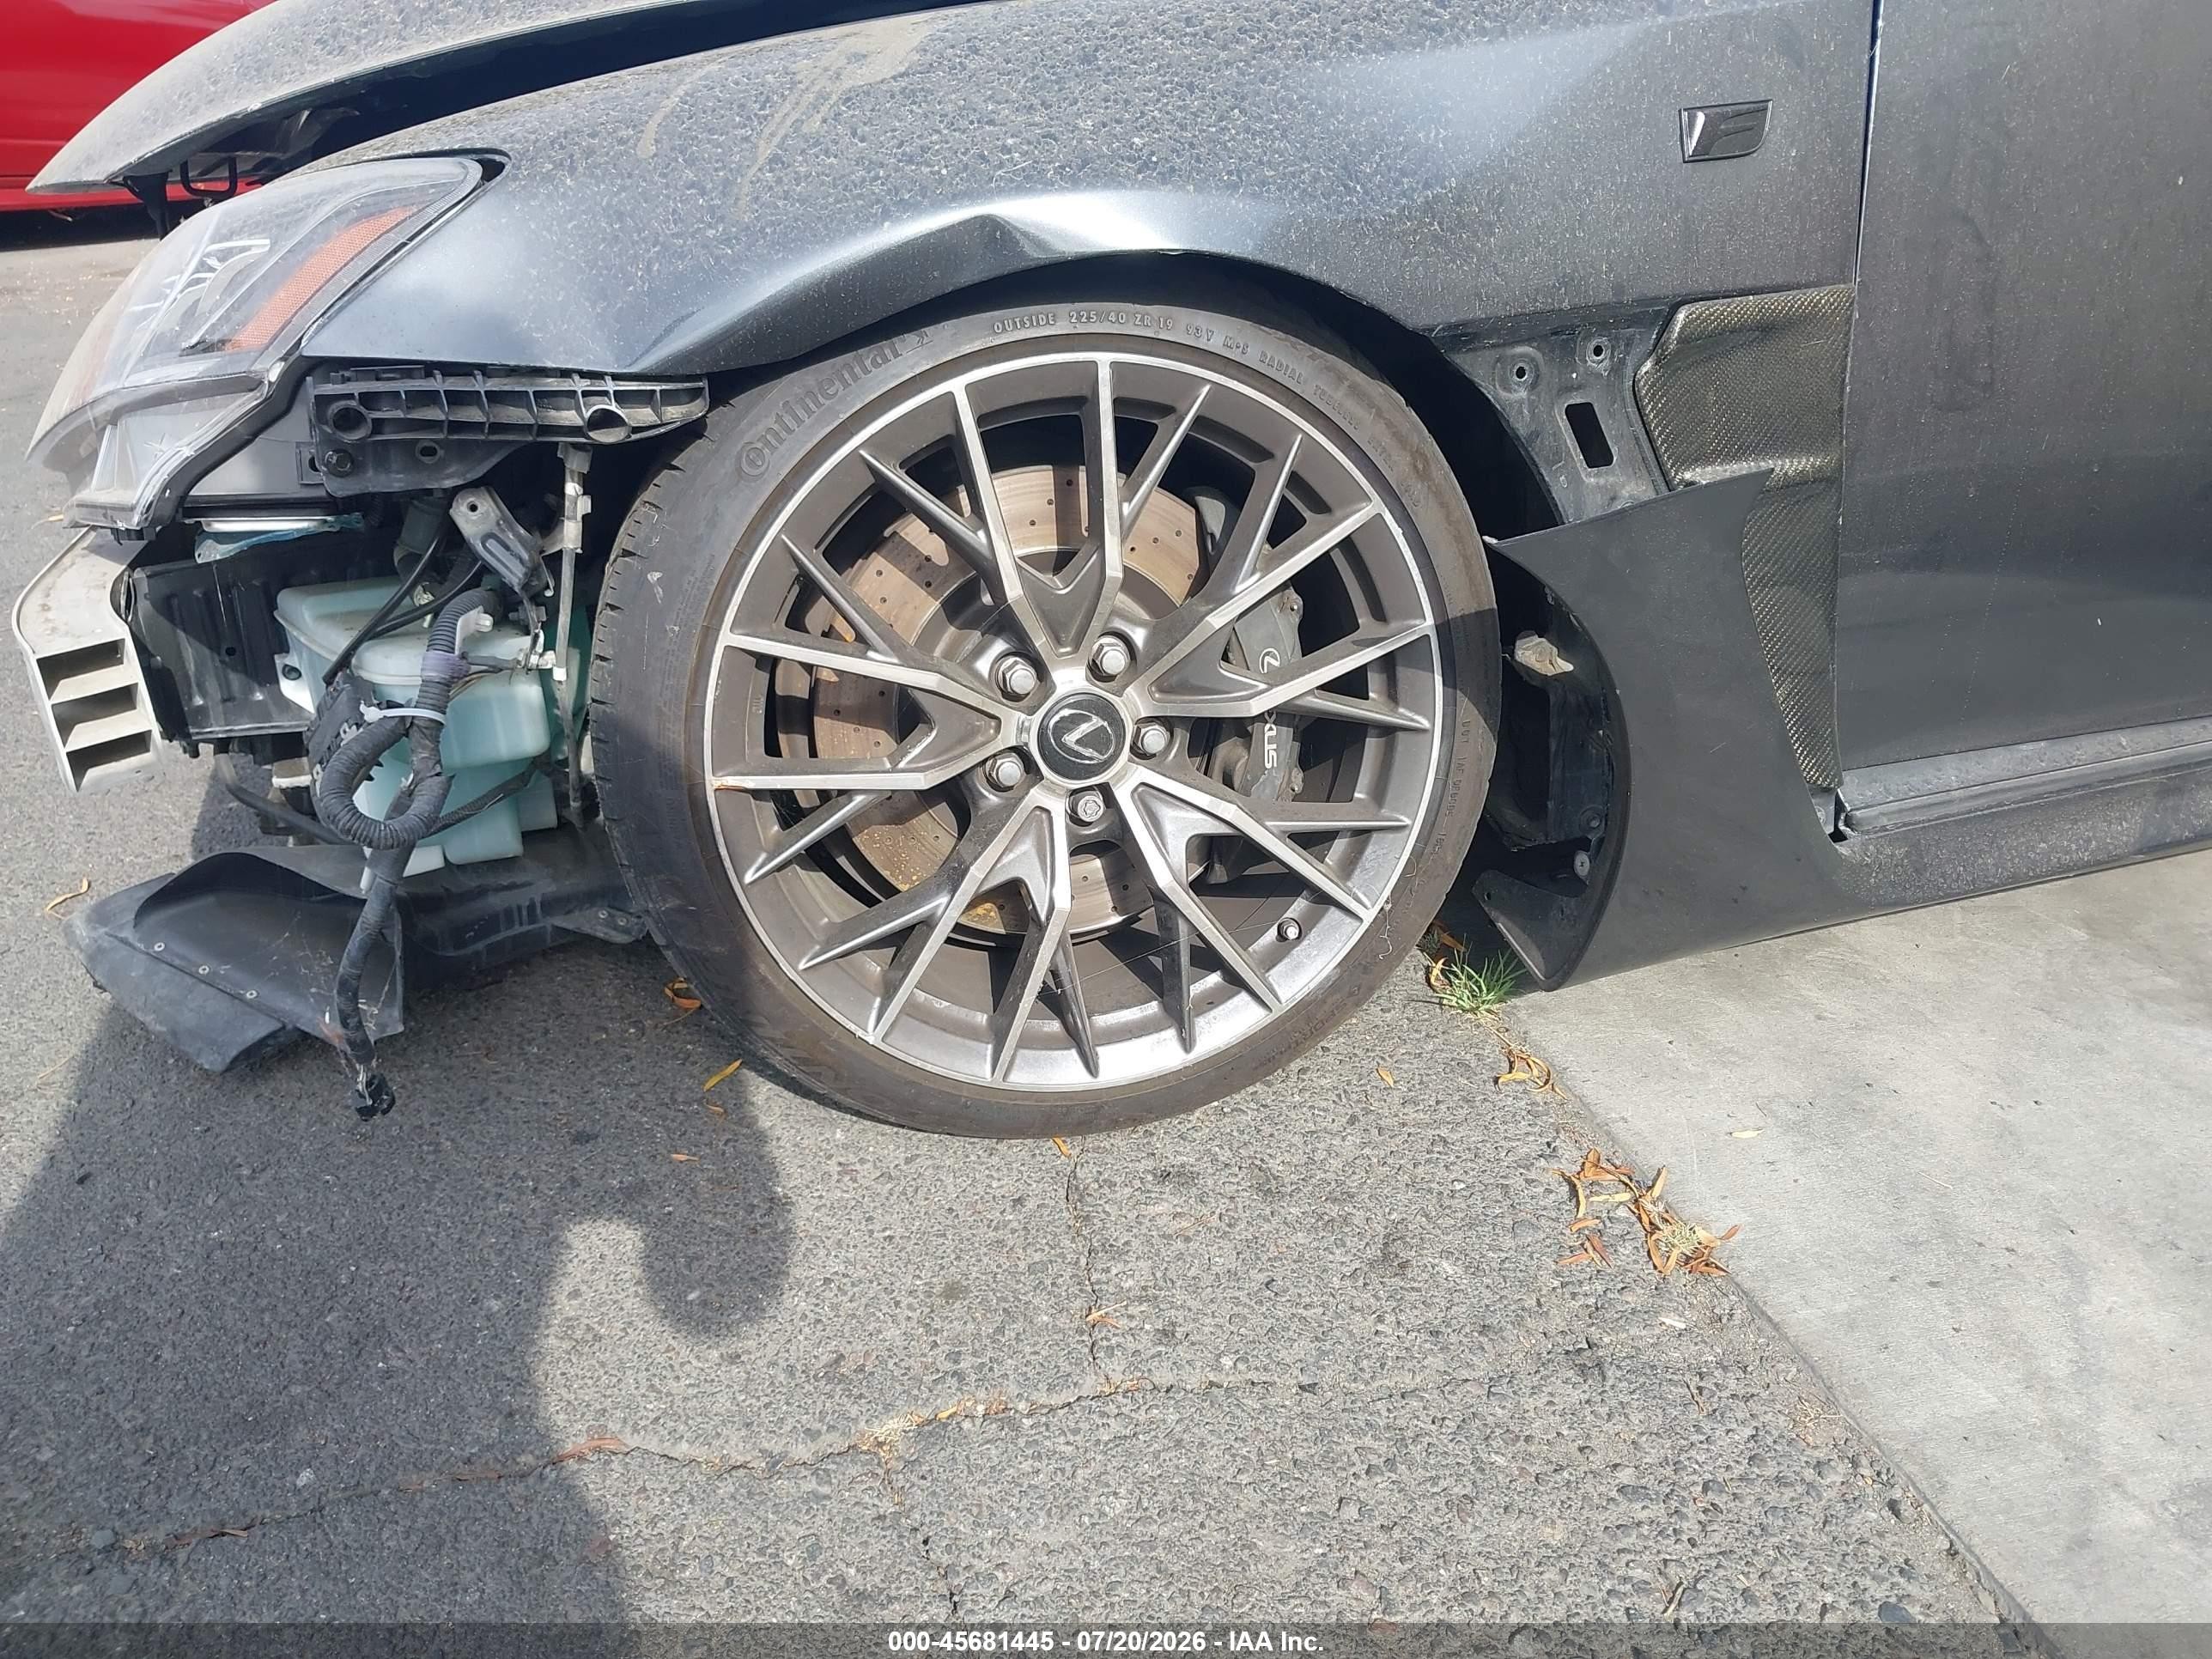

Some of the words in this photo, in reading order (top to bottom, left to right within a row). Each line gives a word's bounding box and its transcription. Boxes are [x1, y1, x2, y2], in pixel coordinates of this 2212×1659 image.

[994, 312, 1056, 334] OUTSIDE
[1069, 310, 1127, 325] 225/40
[1133, 313, 1152, 327] ZR
[1158, 315, 1174, 331] 19
[1258, 349, 1304, 385] RADIAL
[737, 338, 904, 479] Continental
[1263, 710, 1279, 769] XUS
